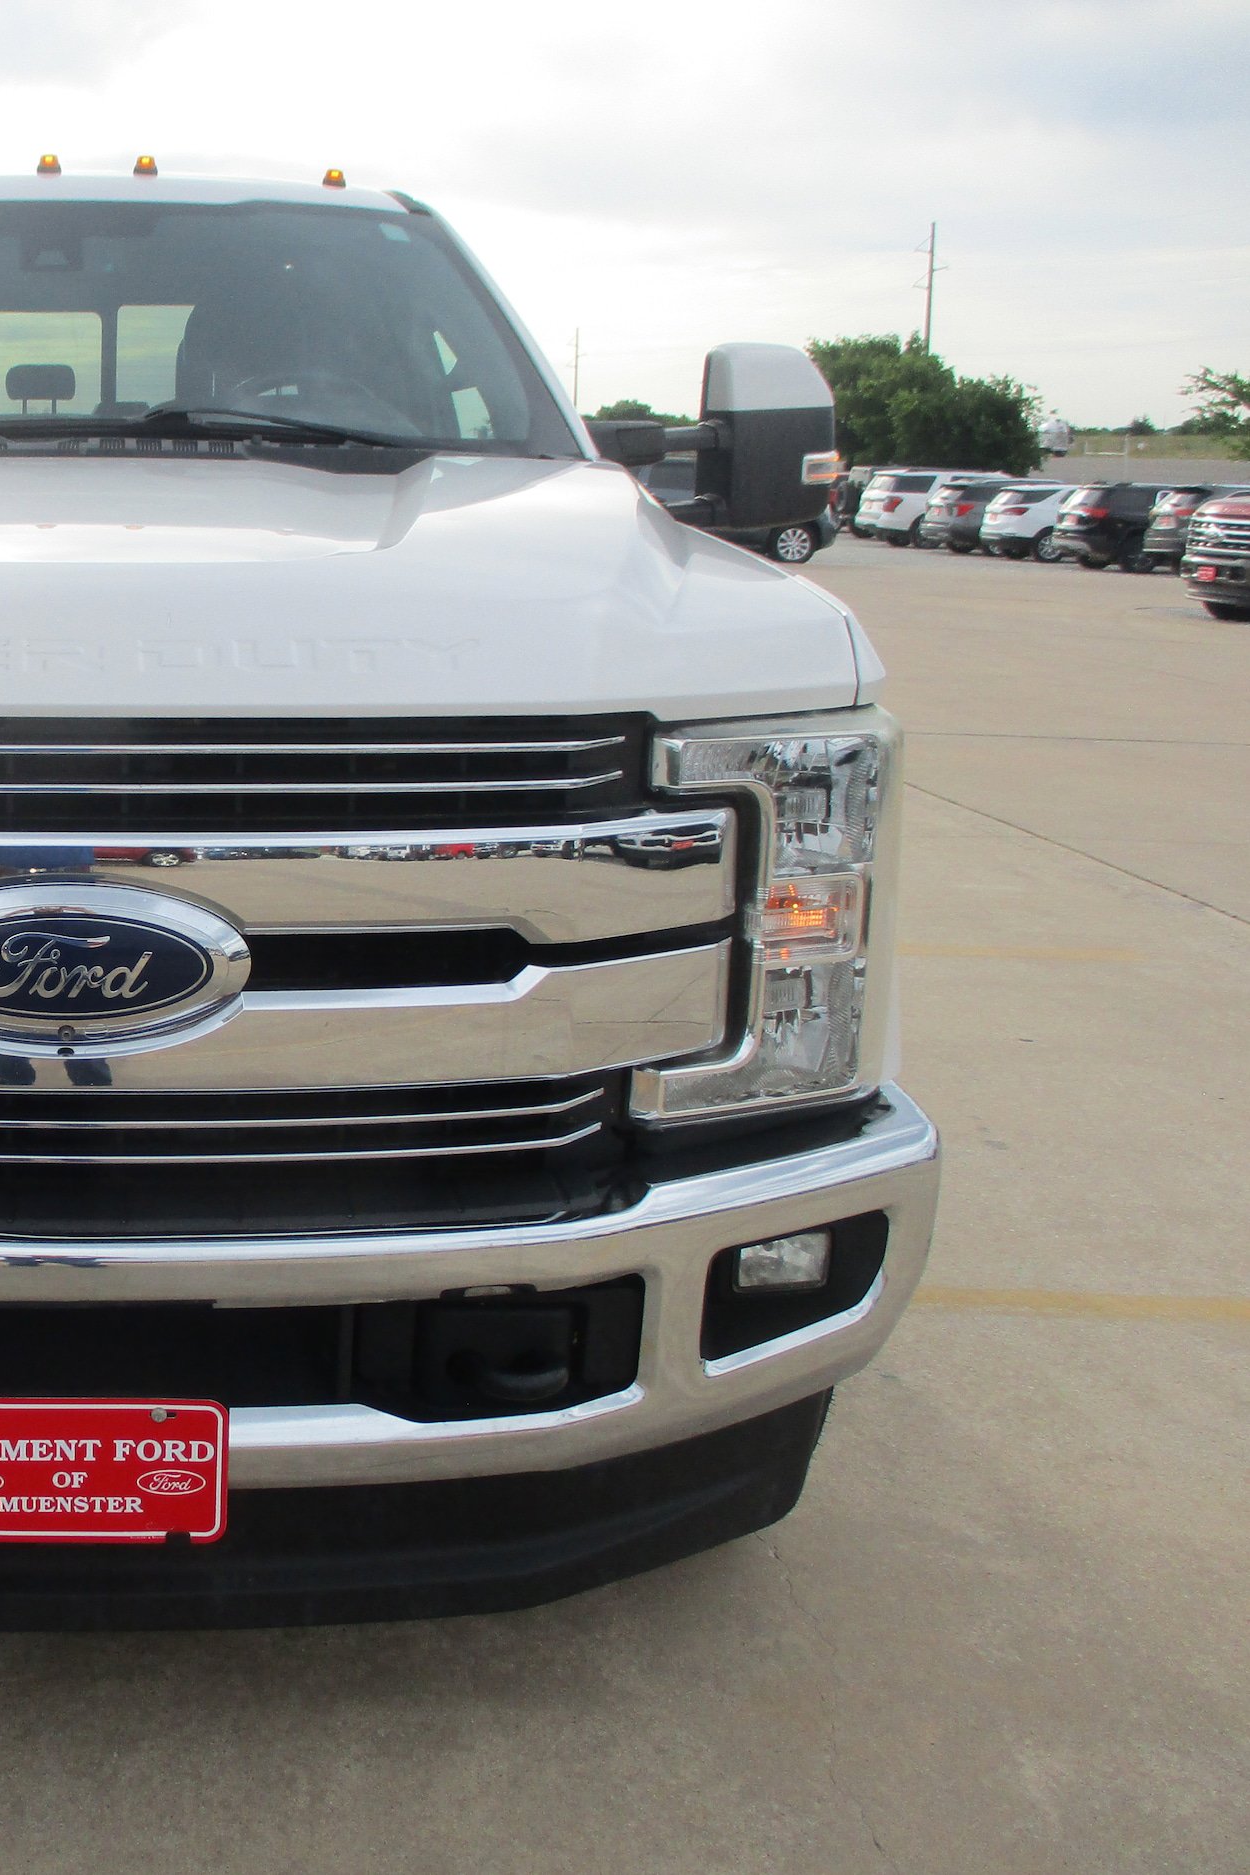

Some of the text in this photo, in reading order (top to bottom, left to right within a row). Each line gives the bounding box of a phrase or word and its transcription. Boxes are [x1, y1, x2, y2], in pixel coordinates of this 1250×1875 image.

[136, 634, 482, 672] DUTY
[113, 1439, 215, 1463] FORD
[52, 1472, 88, 1489] OF
[148, 1473, 191, 1492] Ford
